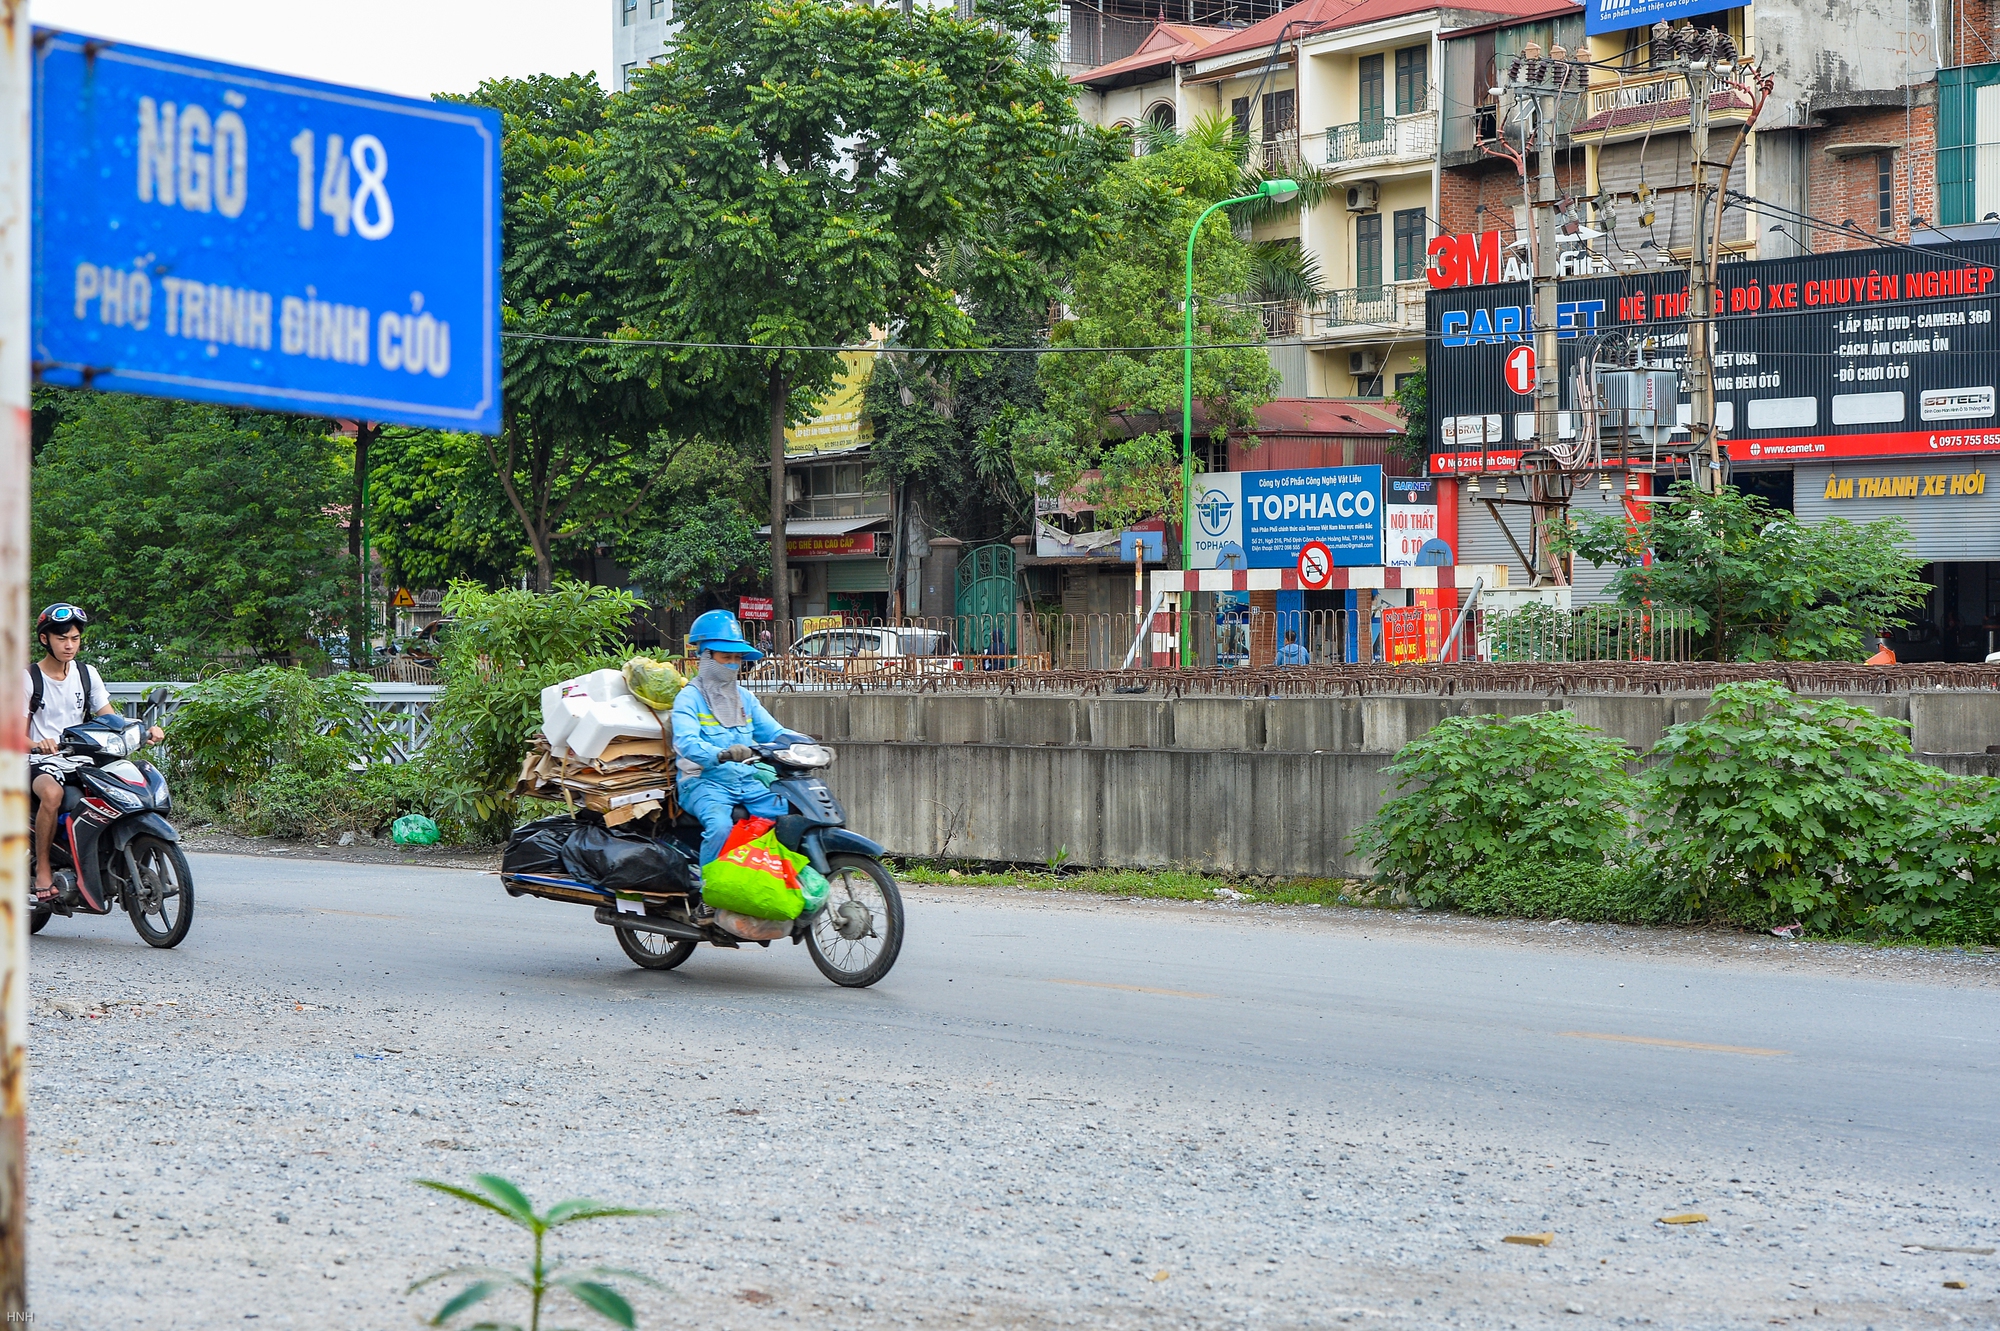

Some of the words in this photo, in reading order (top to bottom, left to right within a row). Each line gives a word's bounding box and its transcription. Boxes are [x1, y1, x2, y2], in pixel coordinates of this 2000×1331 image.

[1630, 6, 1647, 15] hoàn
[1648, 2, 1665, 12] thiện
[137, 89, 248, 219] NGÕ
[290, 128, 395, 241] 148
[1426, 230, 1501, 290] 3M
[1619, 290, 1646, 324] HỆ
[1731, 278, 1761, 317] ĐỘ
[1768, 282, 1798, 309] XE
[1804, 269, 1899, 306] CHUYÊN
[1905, 263, 1995, 299] NGHIỆP
[74, 252, 153, 331] PHỐ
[161, 276, 272, 359] TRỊNH
[280, 284, 370, 367] ĐÌNH
[378, 290, 451, 378] CỬU
[1442, 299, 1606, 348] CARET
[1863, 310, 1885, 335] ĐẶT
[1968, 310, 1992, 324] 360
[1871, 339, 1890, 355] ÂM
[1892, 333, 1931, 354] CHỐNG
[1735, 352, 1758, 366] USA
[1511, 350, 1528, 390] 1
[1735, 373, 1757, 390] ĐÈN
[1759, 370, 1781, 388] ÔTÔ
[1857, 363, 1884, 381] CHƠI
[1886, 361, 1910, 380] ÔTÔ
[1763, 443, 1825, 455] www.carnet.vn
[1939, 436, 1961, 448] 0975
[1963, 435, 1981, 446] 755
[1983, 434, 2000, 446] 855
[1463, 457, 1478, 467] 216
[1393, 481, 1431, 491] CARNET
[1823, 472, 1854, 499] ÂM
[1858, 475, 1919, 499] THANH
[1921, 474, 1947, 496] XE
[1949, 468, 1986, 495] HƠI
[1247, 490, 1375, 521] TOPHACO
[1390, 511, 1408, 533] NỘI
[1410, 509, 1435, 530] THẤT
[813, 539, 824, 549] DA
[824, 538, 838, 549] CAO
[1401, 536, 1408, 555] Ô
[1408, 643, 1417, 654] XE
